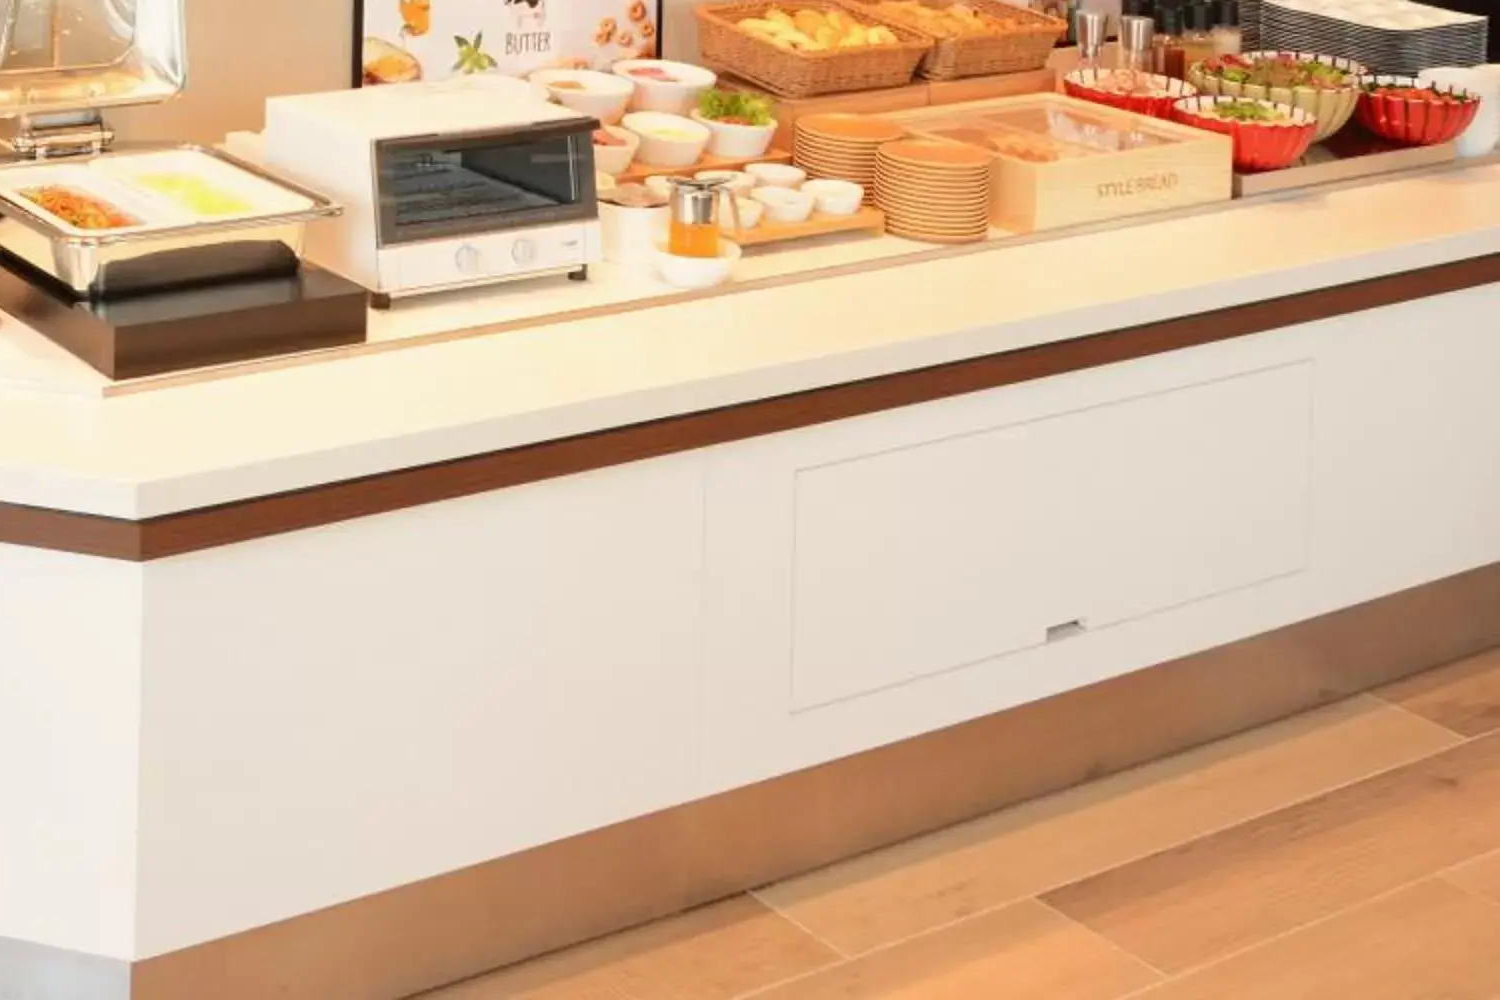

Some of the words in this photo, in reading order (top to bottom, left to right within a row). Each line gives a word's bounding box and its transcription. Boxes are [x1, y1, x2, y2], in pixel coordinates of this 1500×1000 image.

[505, 32, 550, 54] BUTTER
[1097, 180, 1134, 198] STYLE
[1136, 172, 1178, 194] BREAD
